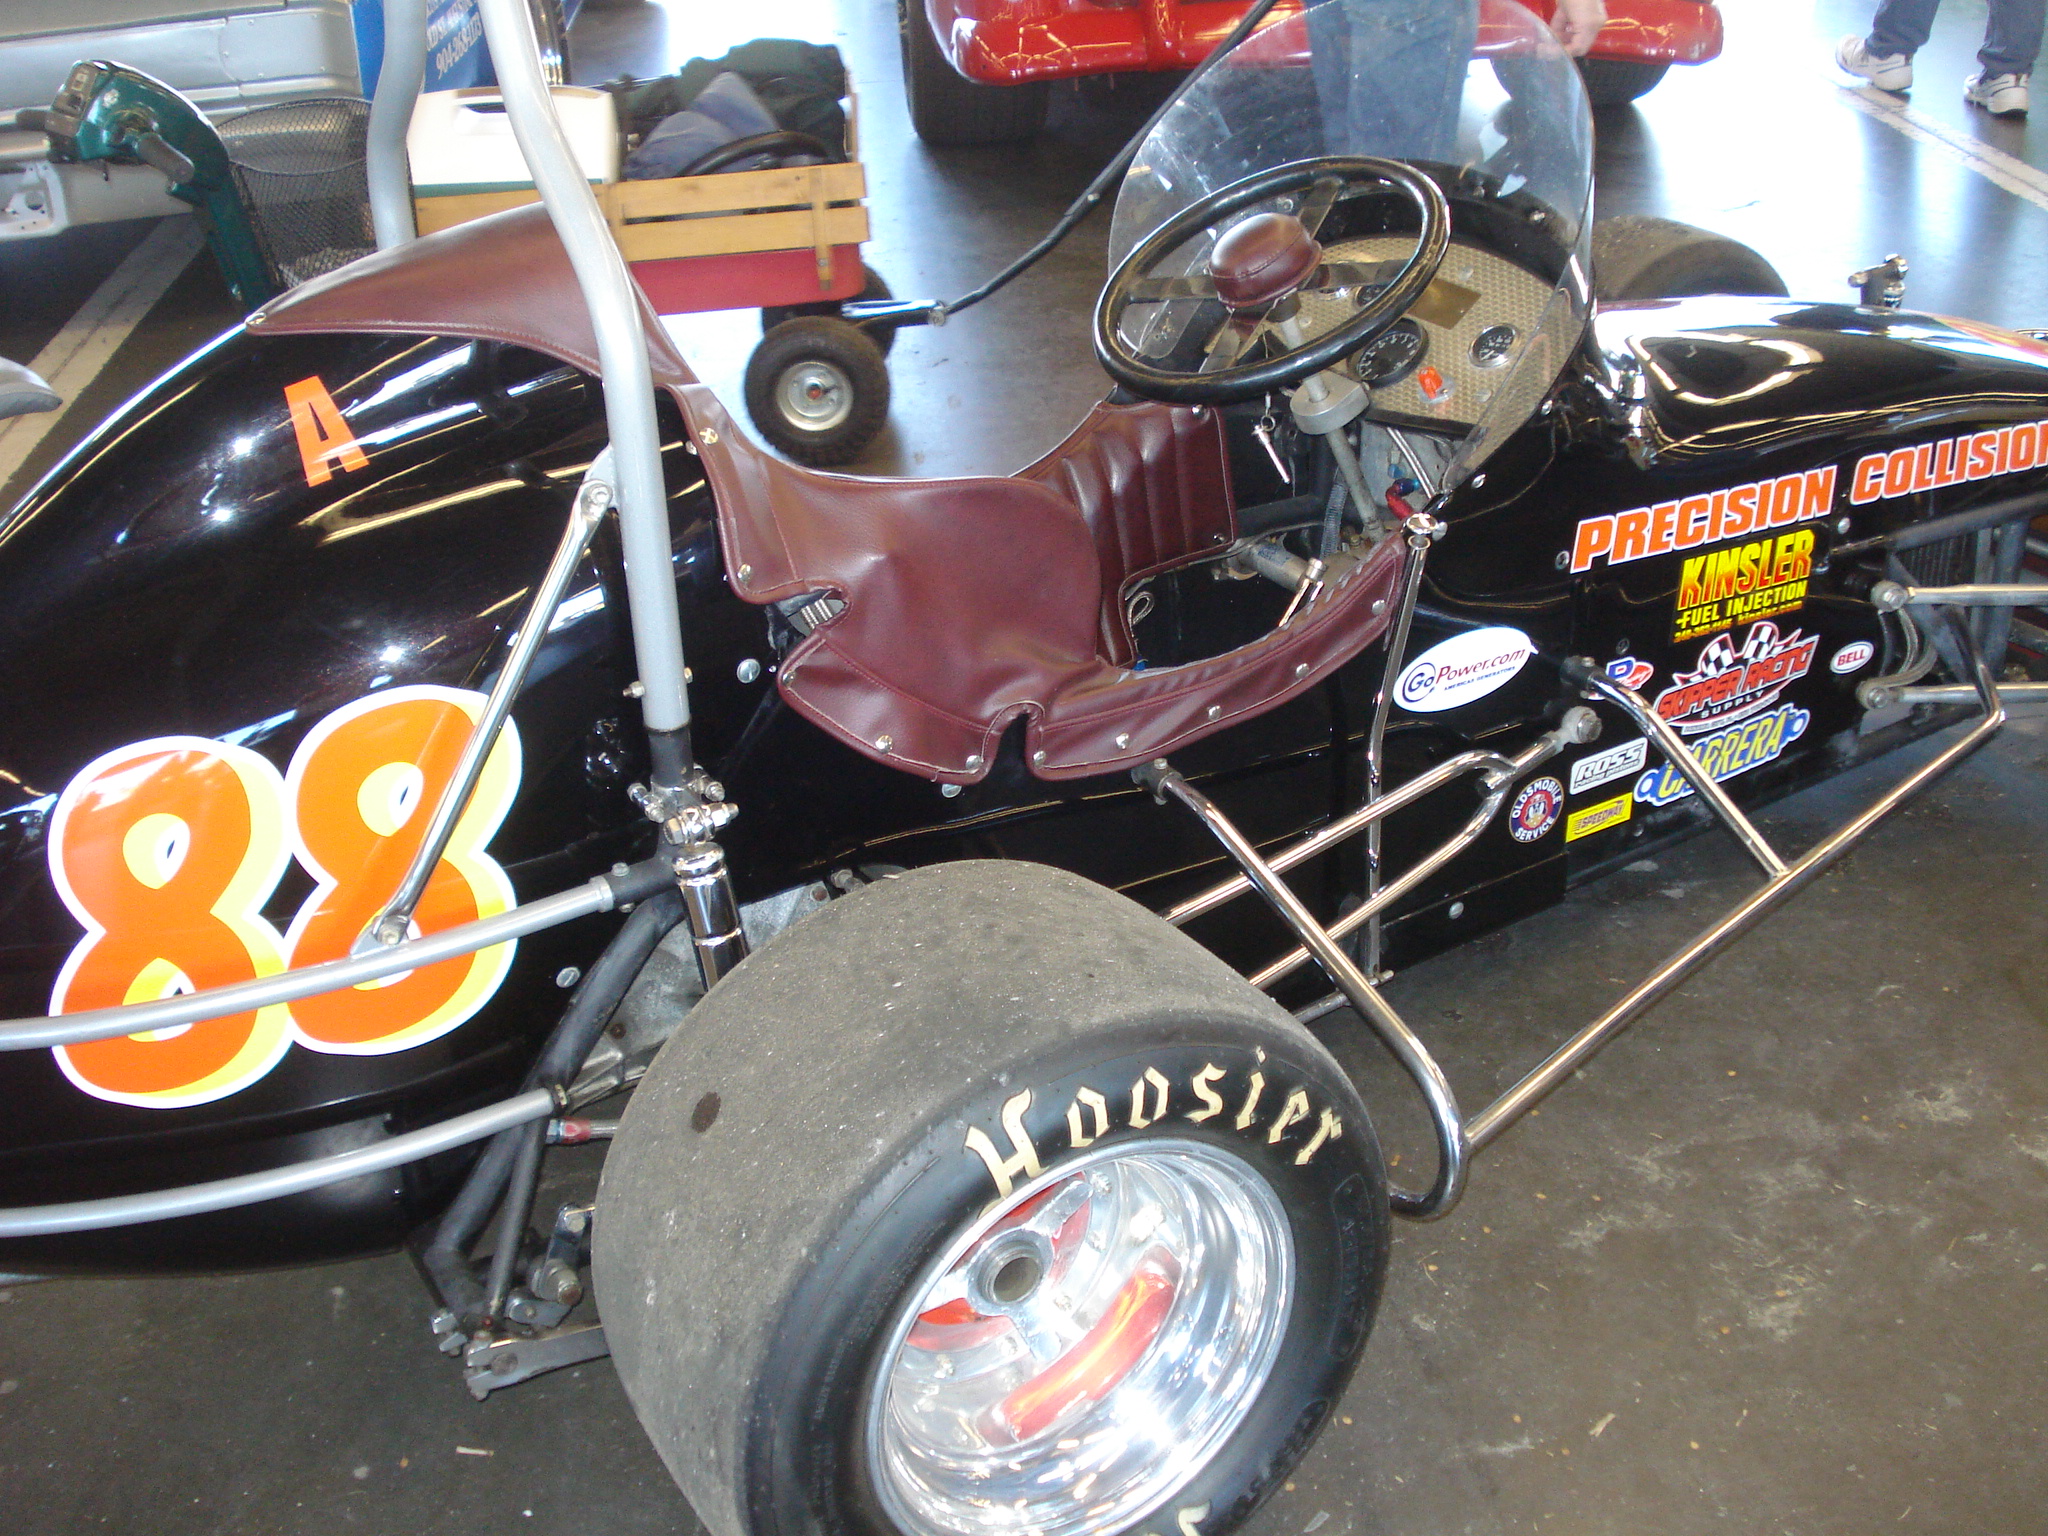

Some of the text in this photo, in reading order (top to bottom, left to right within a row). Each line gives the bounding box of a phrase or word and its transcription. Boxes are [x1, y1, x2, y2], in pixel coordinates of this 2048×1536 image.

[283, 375, 370, 488] A
[1569, 464, 1838, 574] PRECISION
[1677, 529, 1815, 611] KINSLER
[1675, 580, 1808, 629] FUEL INJECTION
[1407, 649, 1526, 693] GoPower.com
[1657, 667, 1744, 720] SKIPPER
[1742, 640, 1813, 692] RACING
[1837, 649, 1865, 667] BELL
[1701, 689, 1764, 718] SUPPLY
[1576, 744, 1643, 781] ROSS
[1512, 779, 1563, 818] OLDSMOBILE
[1515, 815, 1556, 841] SERVICE
[48, 684, 522, 1110] 88
[963, 1045, 1343, 1218] Hoosier
